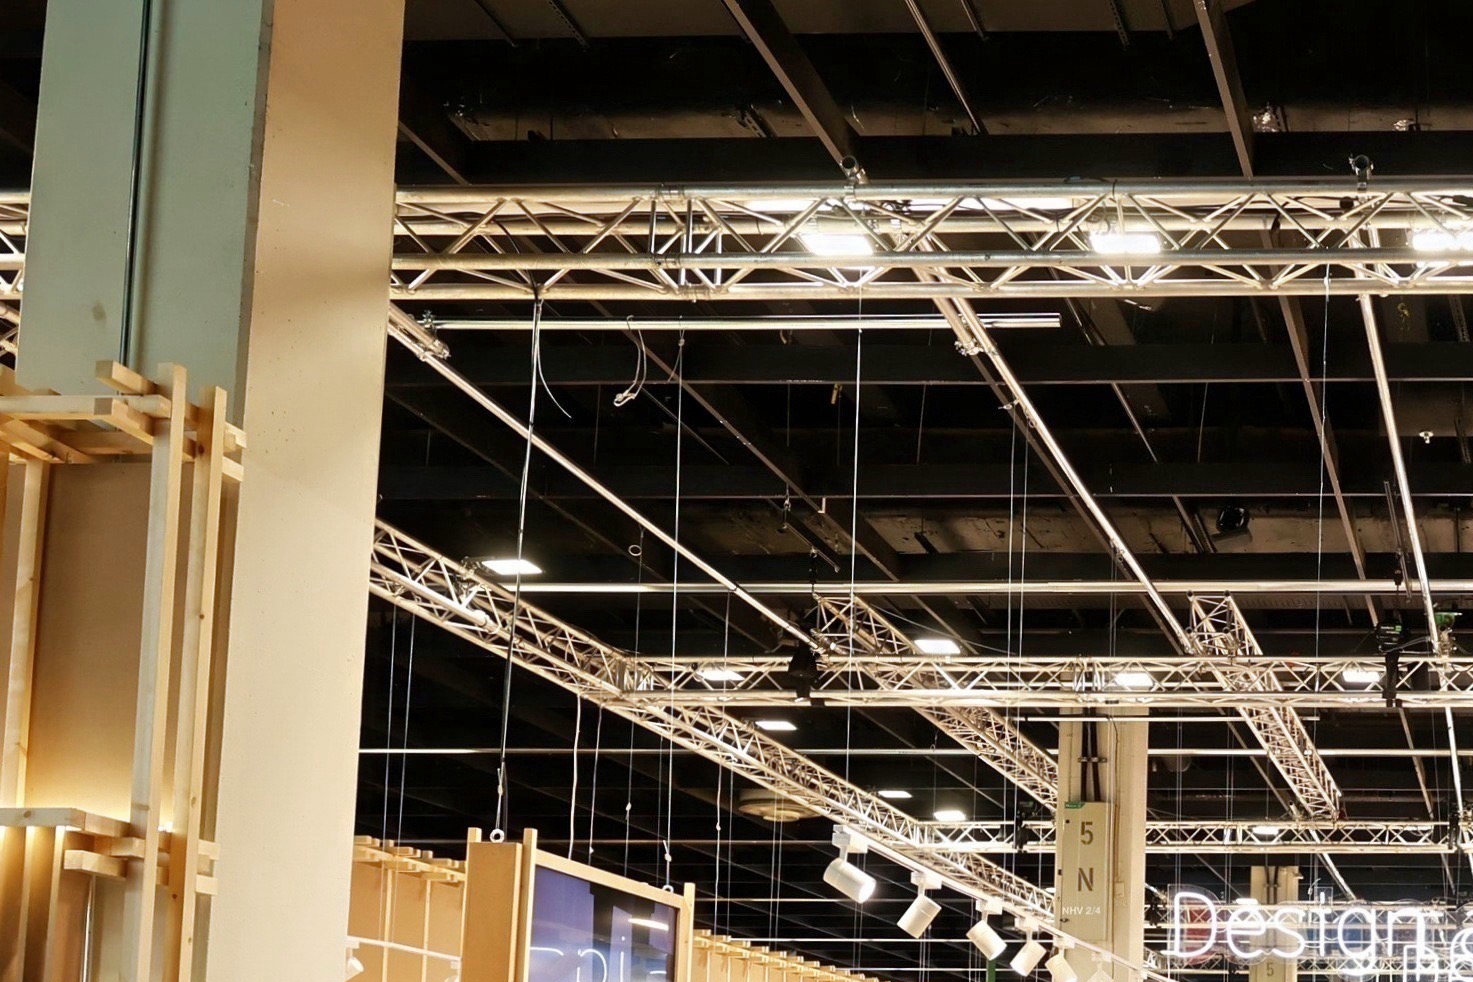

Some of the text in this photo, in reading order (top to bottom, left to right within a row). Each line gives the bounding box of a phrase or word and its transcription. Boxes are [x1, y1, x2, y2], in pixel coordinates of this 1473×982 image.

[1080, 821, 1094, 845] 5
[1077, 867, 1094, 891] N
[1062, 906, 1101, 915] NHV 2/4
[1173, 891, 1424, 976] Design
[1266, 963, 1275, 976] 5
